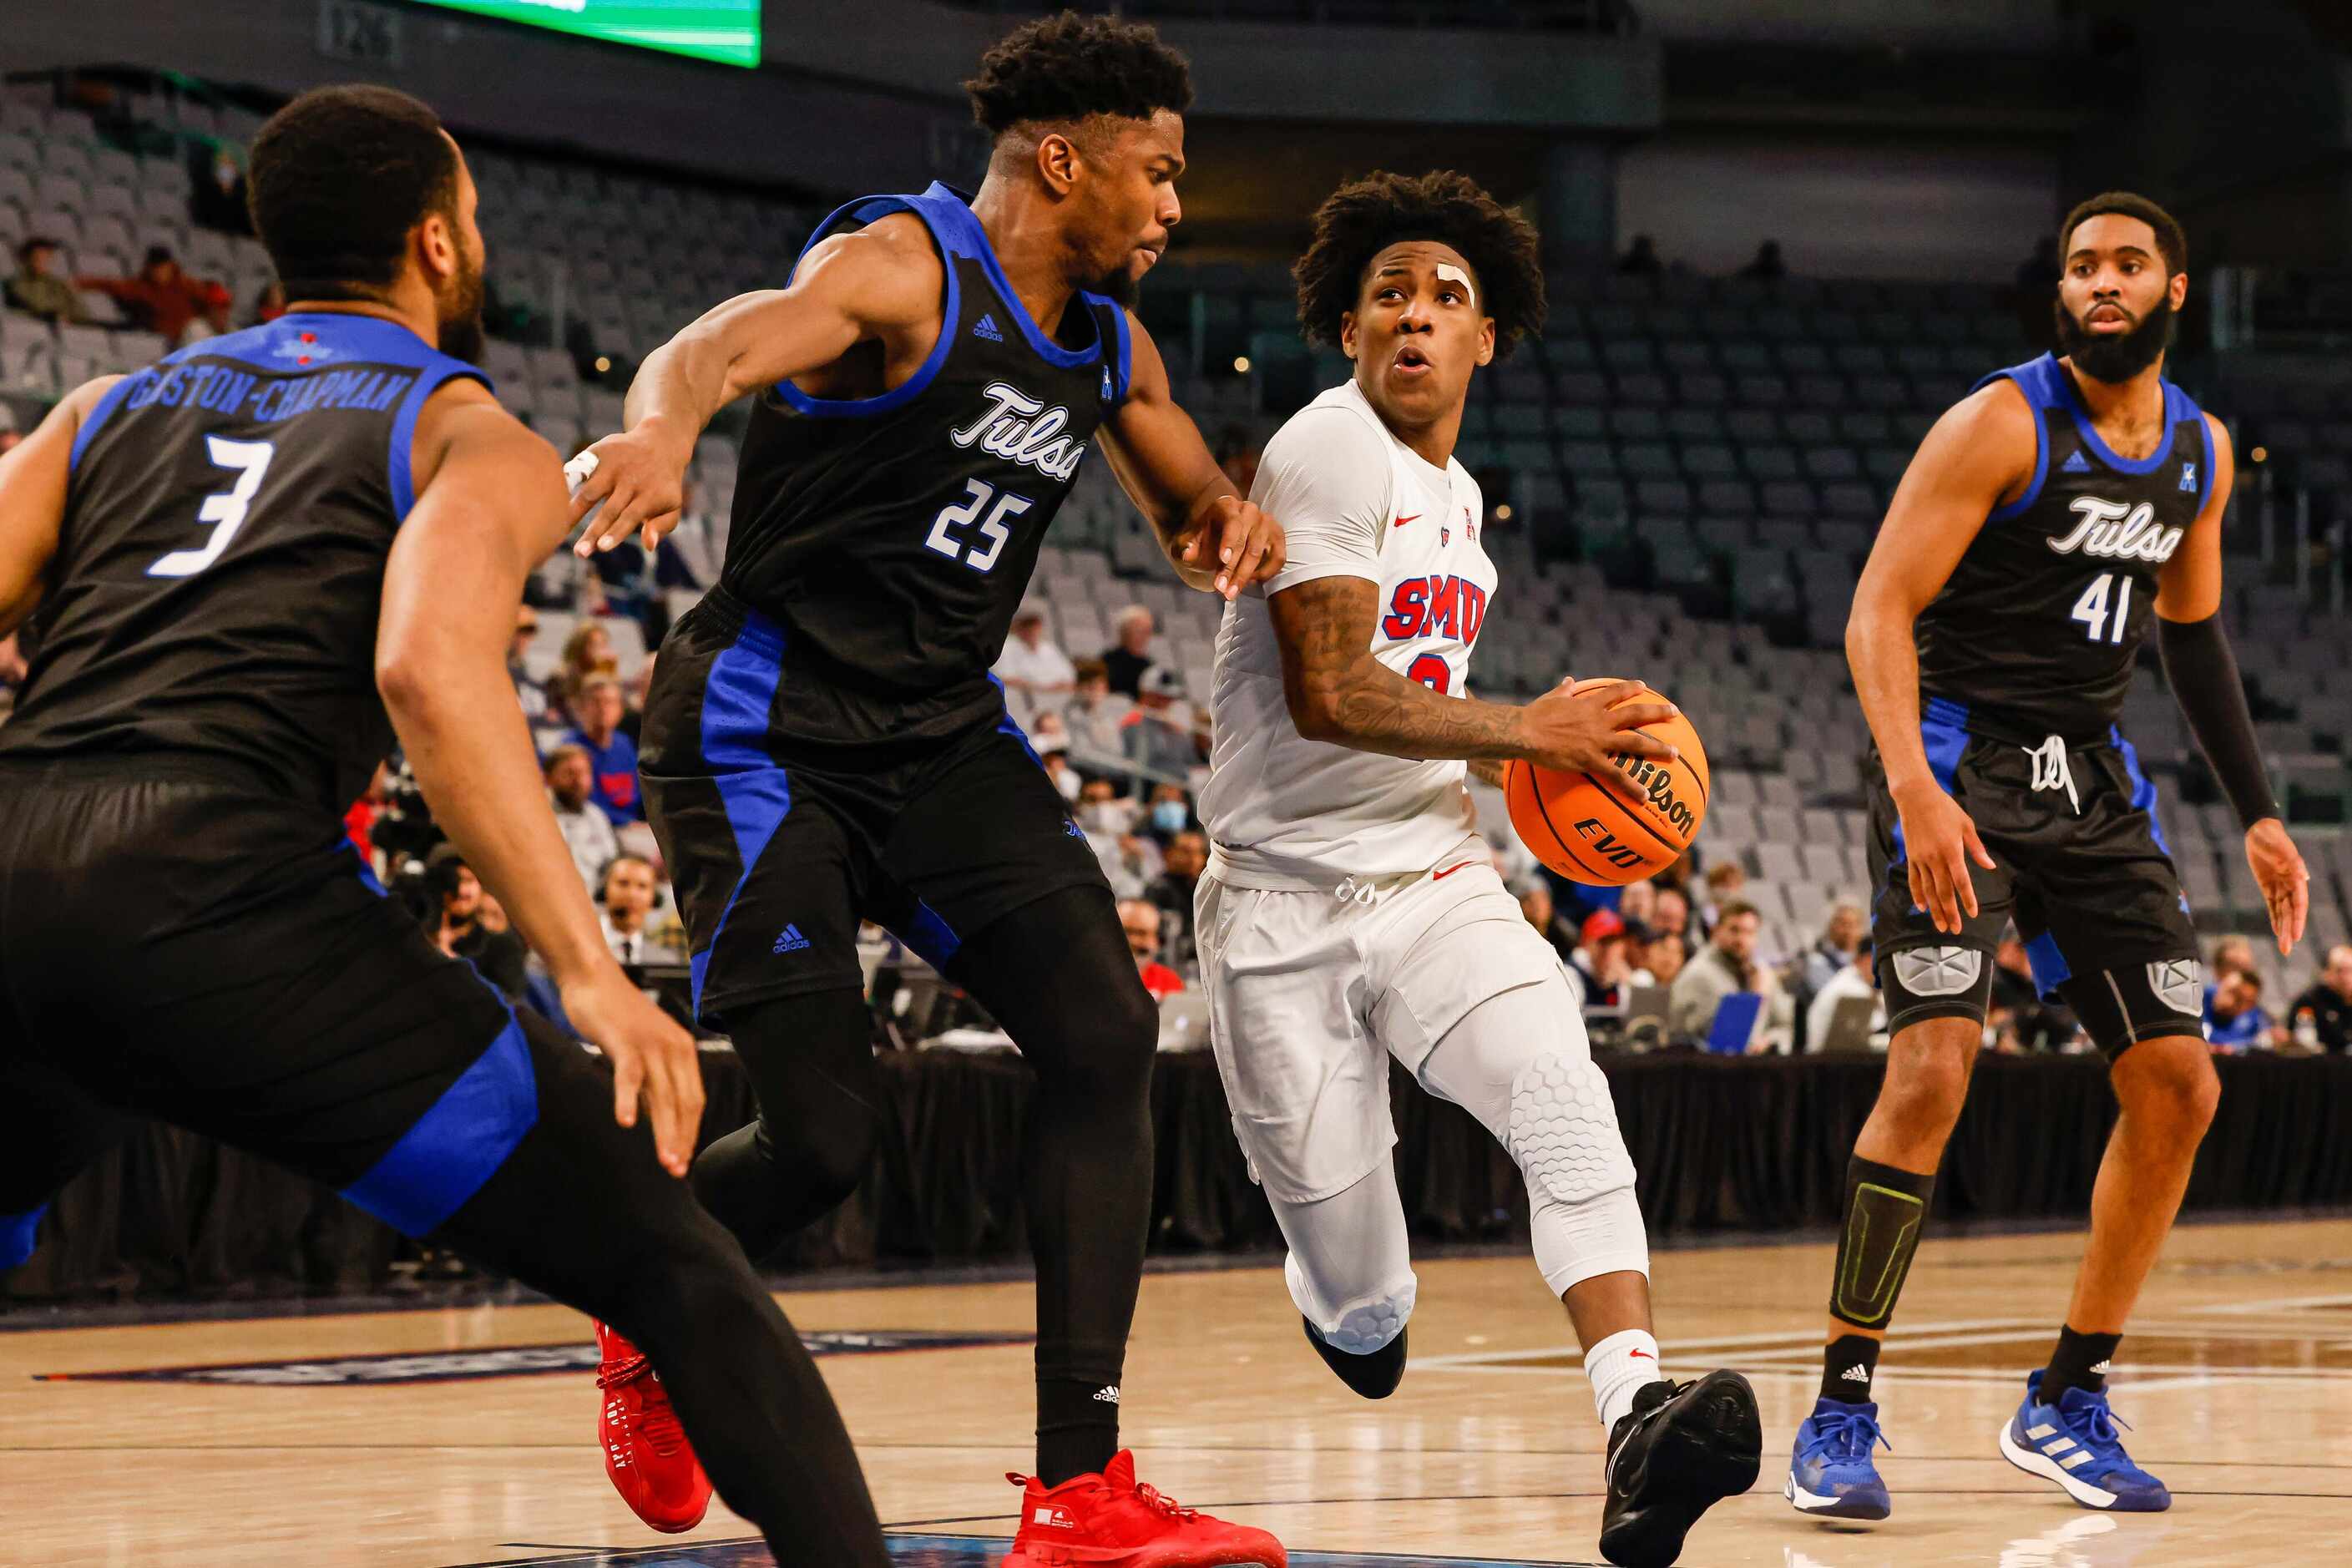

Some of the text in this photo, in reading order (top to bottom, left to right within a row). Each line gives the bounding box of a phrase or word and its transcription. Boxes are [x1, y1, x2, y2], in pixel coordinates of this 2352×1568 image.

[950, 379, 1087, 483] Tulsa
[144, 433, 276, 579] 3
[923, 476, 1035, 572] 25
[2046, 495, 2185, 564] Tulsa
[1382, 574, 1486, 649] SMU
[2070, 571, 2134, 645] 41
[1574, 817, 1644, 868] EVO
[772, 938, 811, 953] adidas
